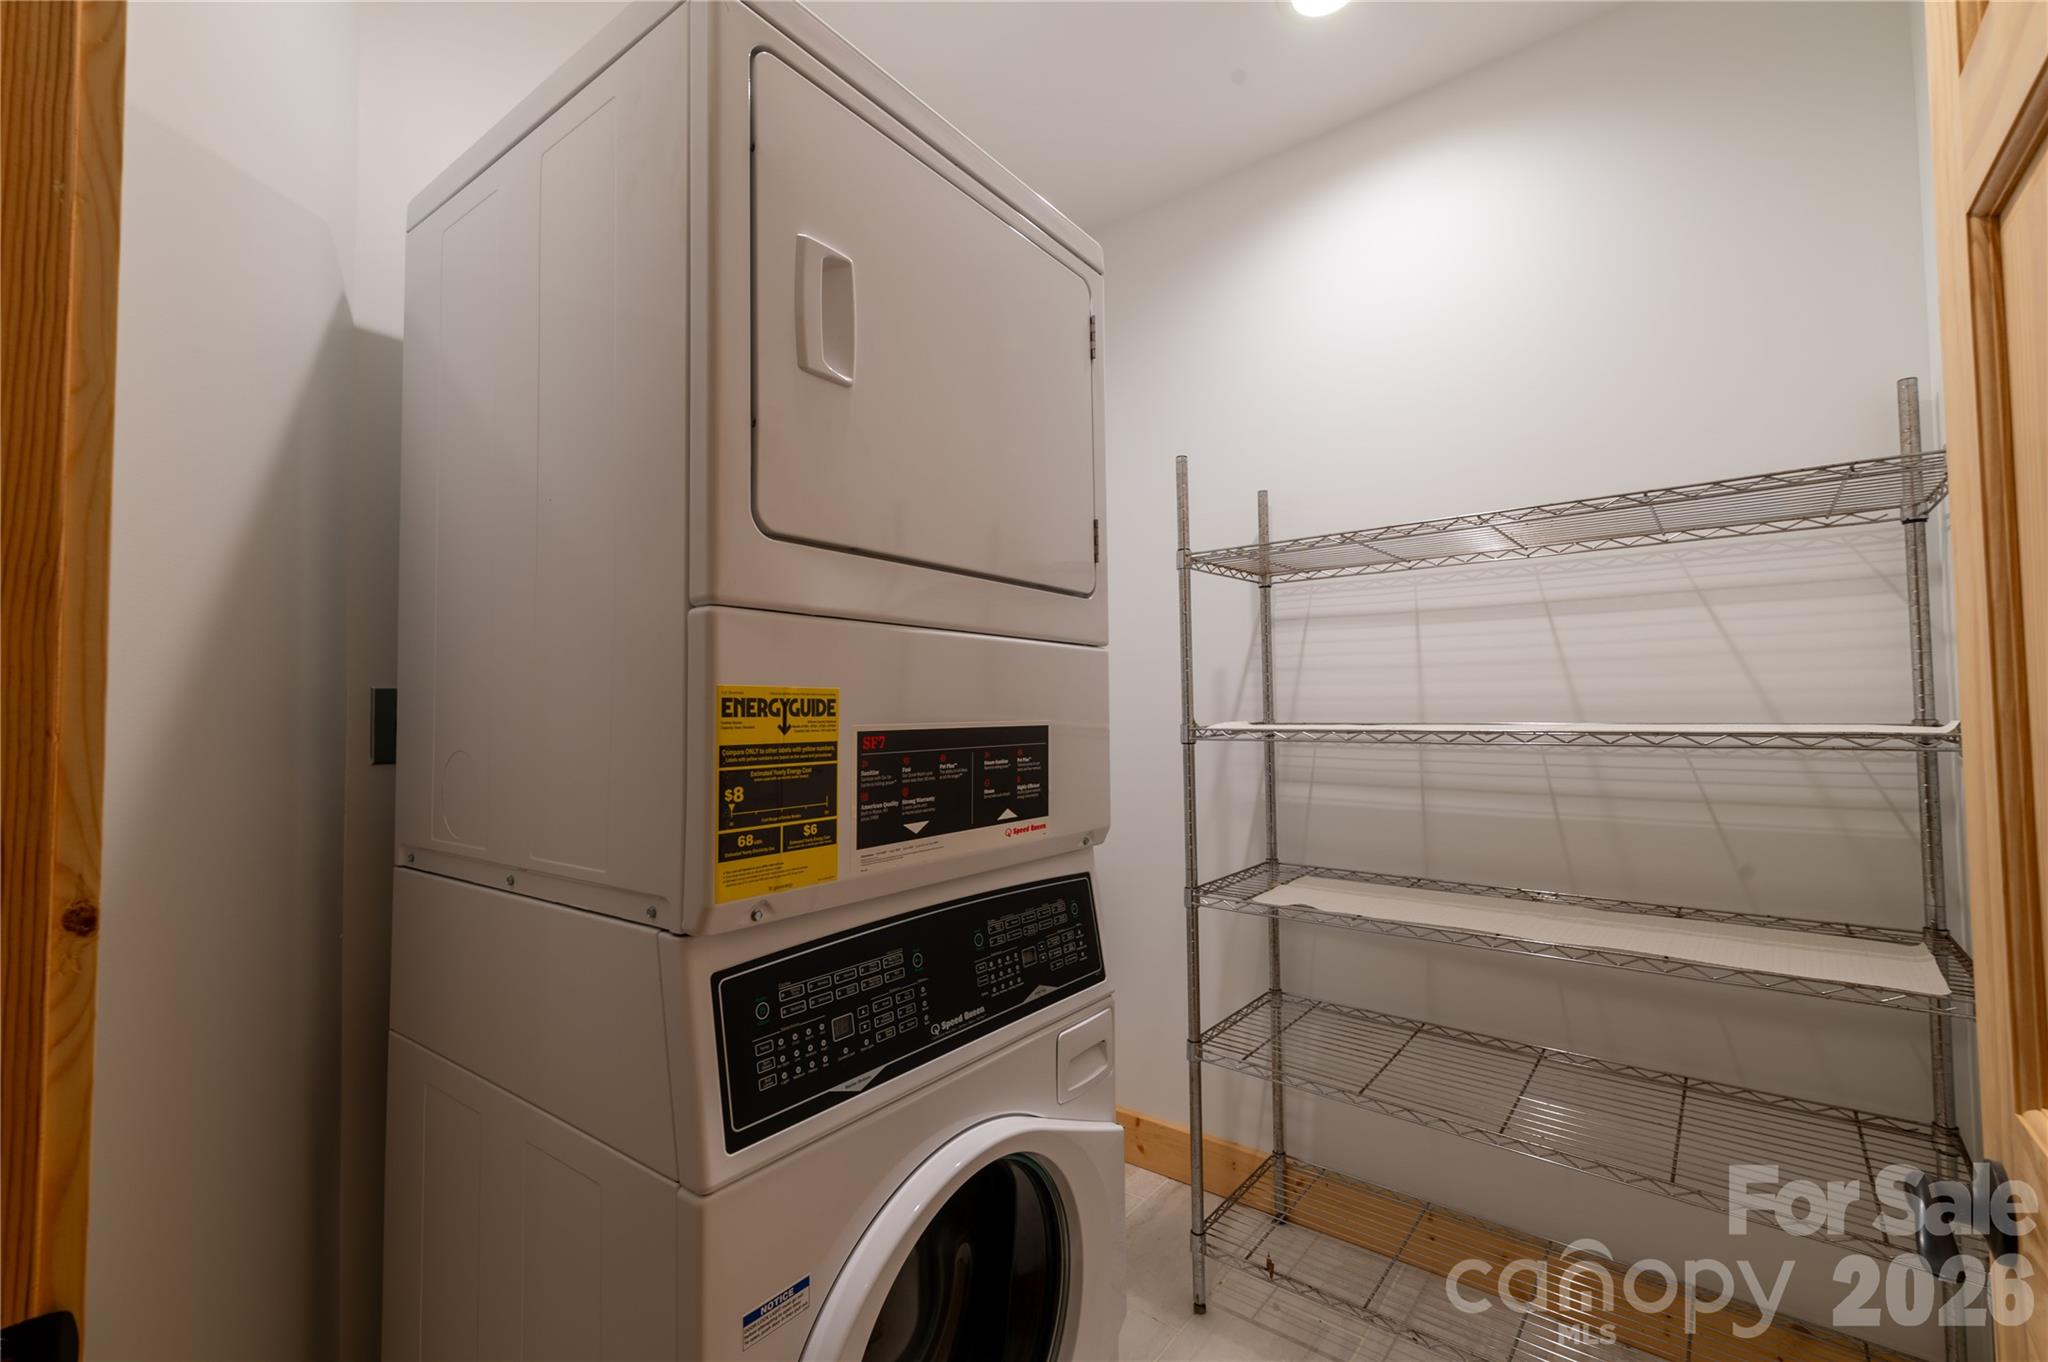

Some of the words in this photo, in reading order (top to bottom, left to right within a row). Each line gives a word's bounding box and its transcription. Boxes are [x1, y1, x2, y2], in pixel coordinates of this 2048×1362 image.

[721, 697, 837, 718] ENERGYGUIDE
[863, 735, 887, 751] SF7
[745, 747, 759, 756] ONLY
[724, 786, 744, 803] $8
[803, 823, 818, 836] $6
[737, 834, 754, 847] 68
[940, 1014, 963, 1031] Speed
[964, 1006, 986, 1021] Queen
[760, 1287, 794, 1316] NOTICE
